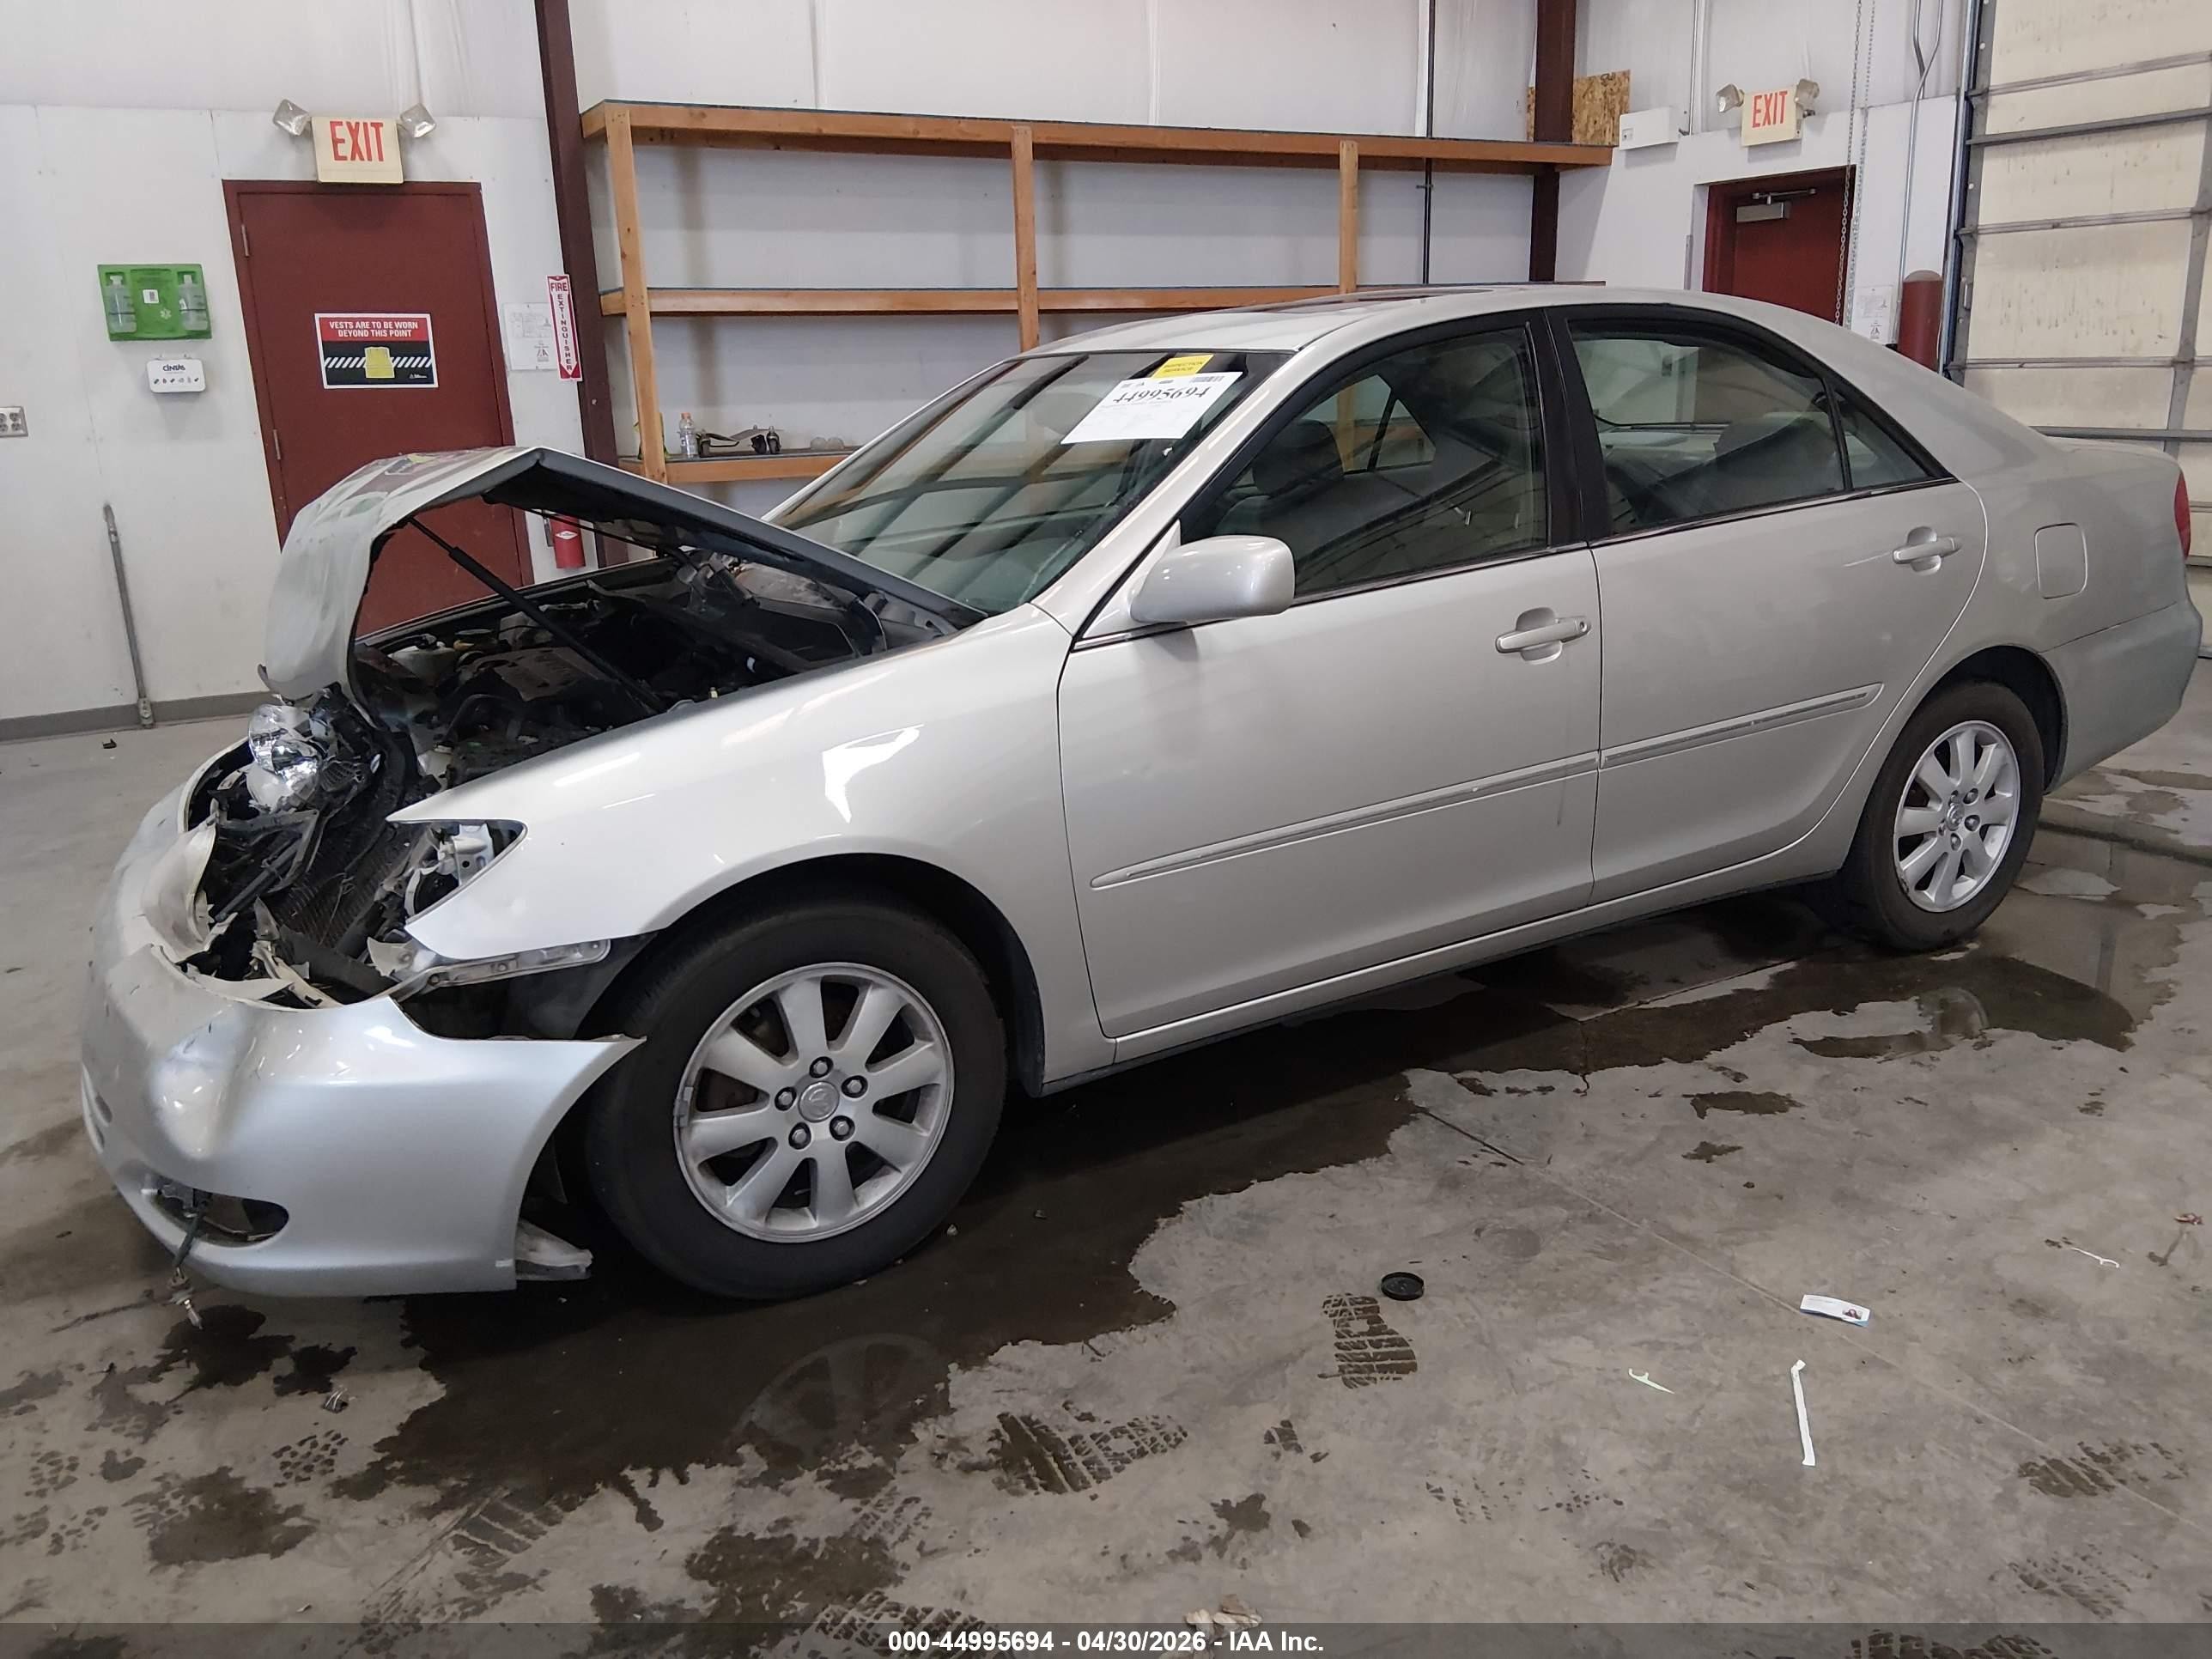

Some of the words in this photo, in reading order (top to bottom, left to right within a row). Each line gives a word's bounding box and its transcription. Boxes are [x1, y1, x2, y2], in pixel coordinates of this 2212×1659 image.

[1752, 90, 1788, 128] EXIT
[329, 121, 385, 161] EXIT
[550, 283, 568, 292] FIRE
[337, 329, 368, 337] BEYOND
[370, 329, 388, 337] THIS
[389, 329, 412, 337] POINT
[394, 321, 418, 330] WORN
[557, 294, 572, 370] EXTINGUISHER
[1113, 386, 1211, 402] 44995694
